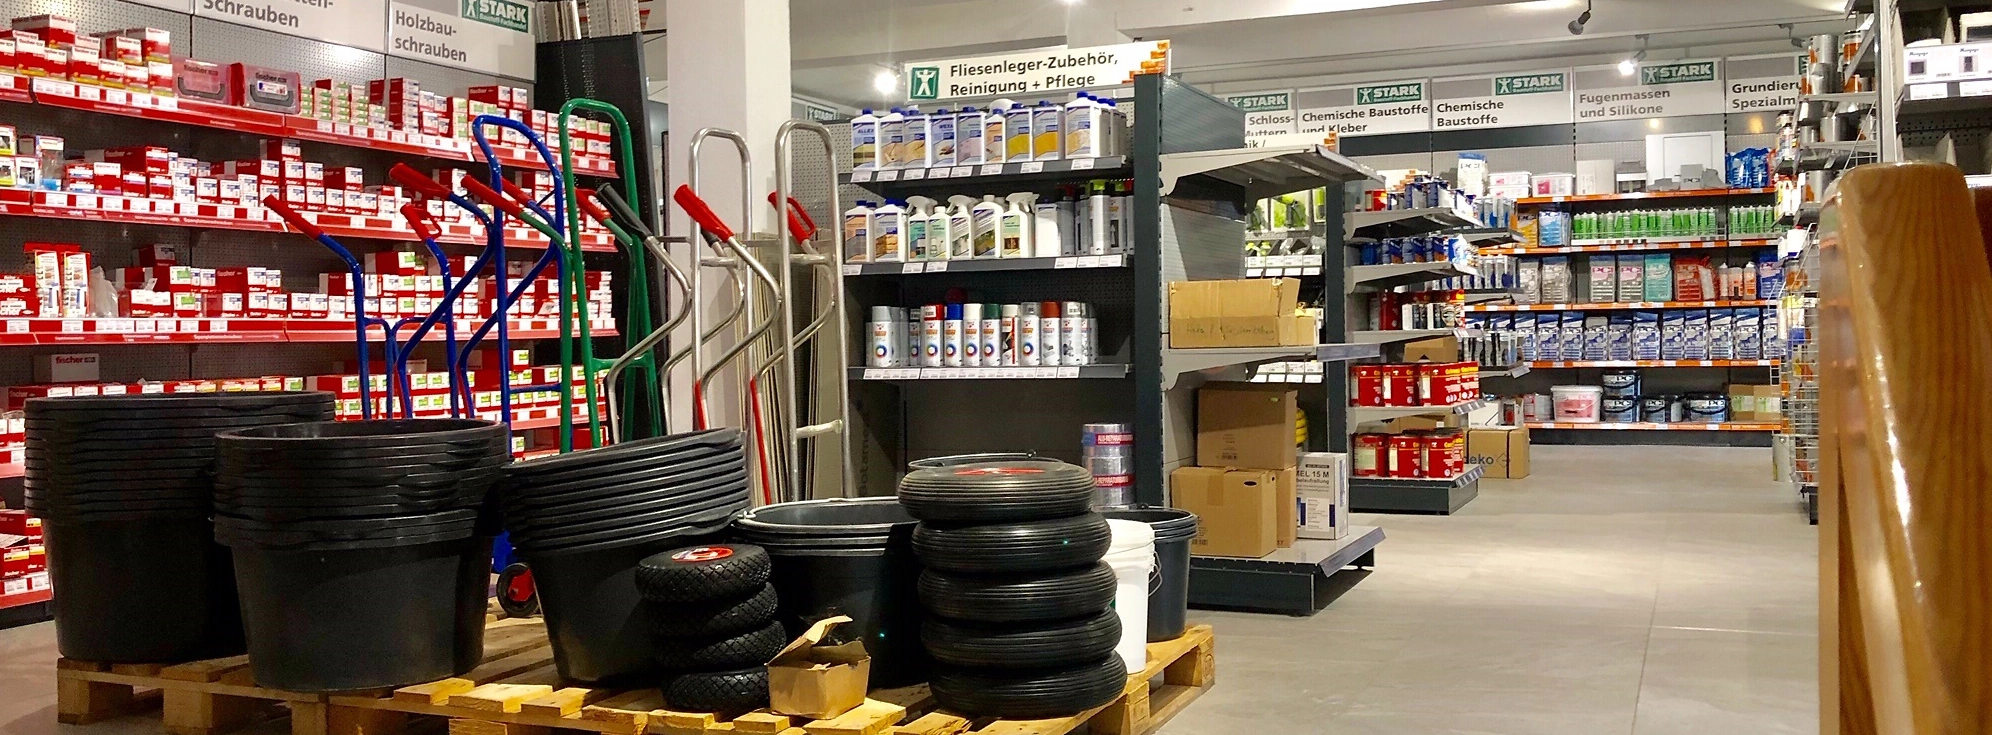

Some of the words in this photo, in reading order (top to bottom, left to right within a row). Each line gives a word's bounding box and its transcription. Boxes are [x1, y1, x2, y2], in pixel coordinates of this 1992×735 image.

[203, 0, 299, 28] Schrauben
[479, 1, 527, 24] STARK
[395, 10, 457, 36] Holzbau-
[395, 37, 467, 62] schrauben
[950, 53, 1118, 78] Fliesenleger-Zubehör,
[1659, 64, 1712, 79] STARK
[950, 79, 1027, 96] Reinigung
[1032, 80, 1041, 90] +
[1046, 74, 1095, 89] Pflege
[1513, 74, 1562, 88] STARK
[1373, 84, 1421, 98] STARK
[1579, 89, 1670, 105] Fugenmassen
[1243, 95, 1287, 108] STARK
[1437, 100, 1504, 113] Chemische
[1302, 109, 1366, 122] Chemische
[1369, 104, 1429, 117] Baustoffe
[1579, 109, 1605, 118] und
[1609, 105, 1663, 117] Silikone
[1249, 115, 1295, 125] Schloss-
[1437, 115, 1498, 127] Baustoffe
[1329, 124, 1367, 134] Kleber
[56, 355, 83, 364] fischer
